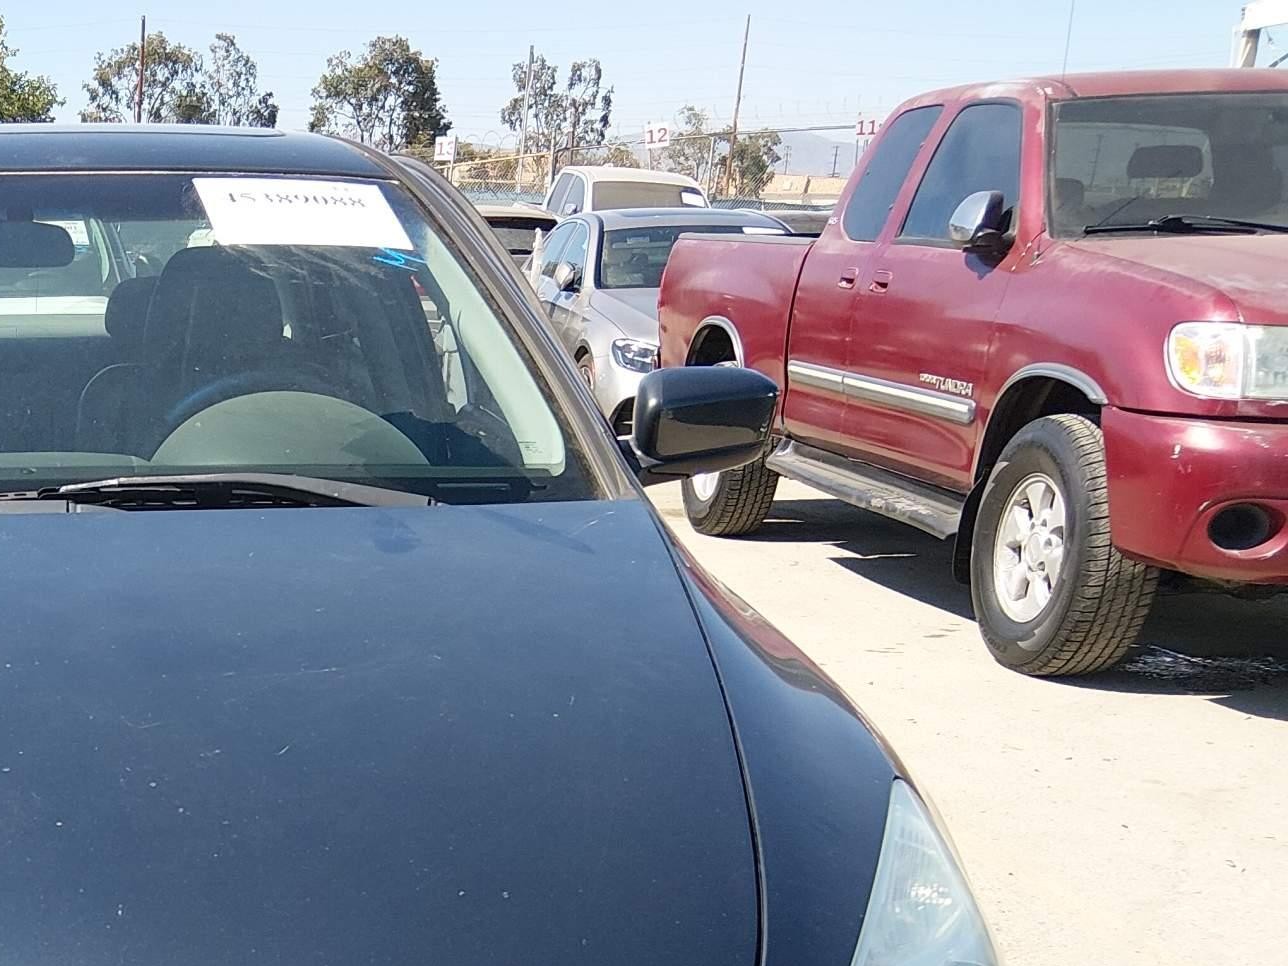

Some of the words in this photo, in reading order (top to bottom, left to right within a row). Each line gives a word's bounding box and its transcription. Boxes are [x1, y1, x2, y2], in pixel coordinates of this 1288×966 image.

[647, 127, 668, 144] 12
[856, 120, 876, 135] 11
[935, 376, 974, 397] TUNDRA
